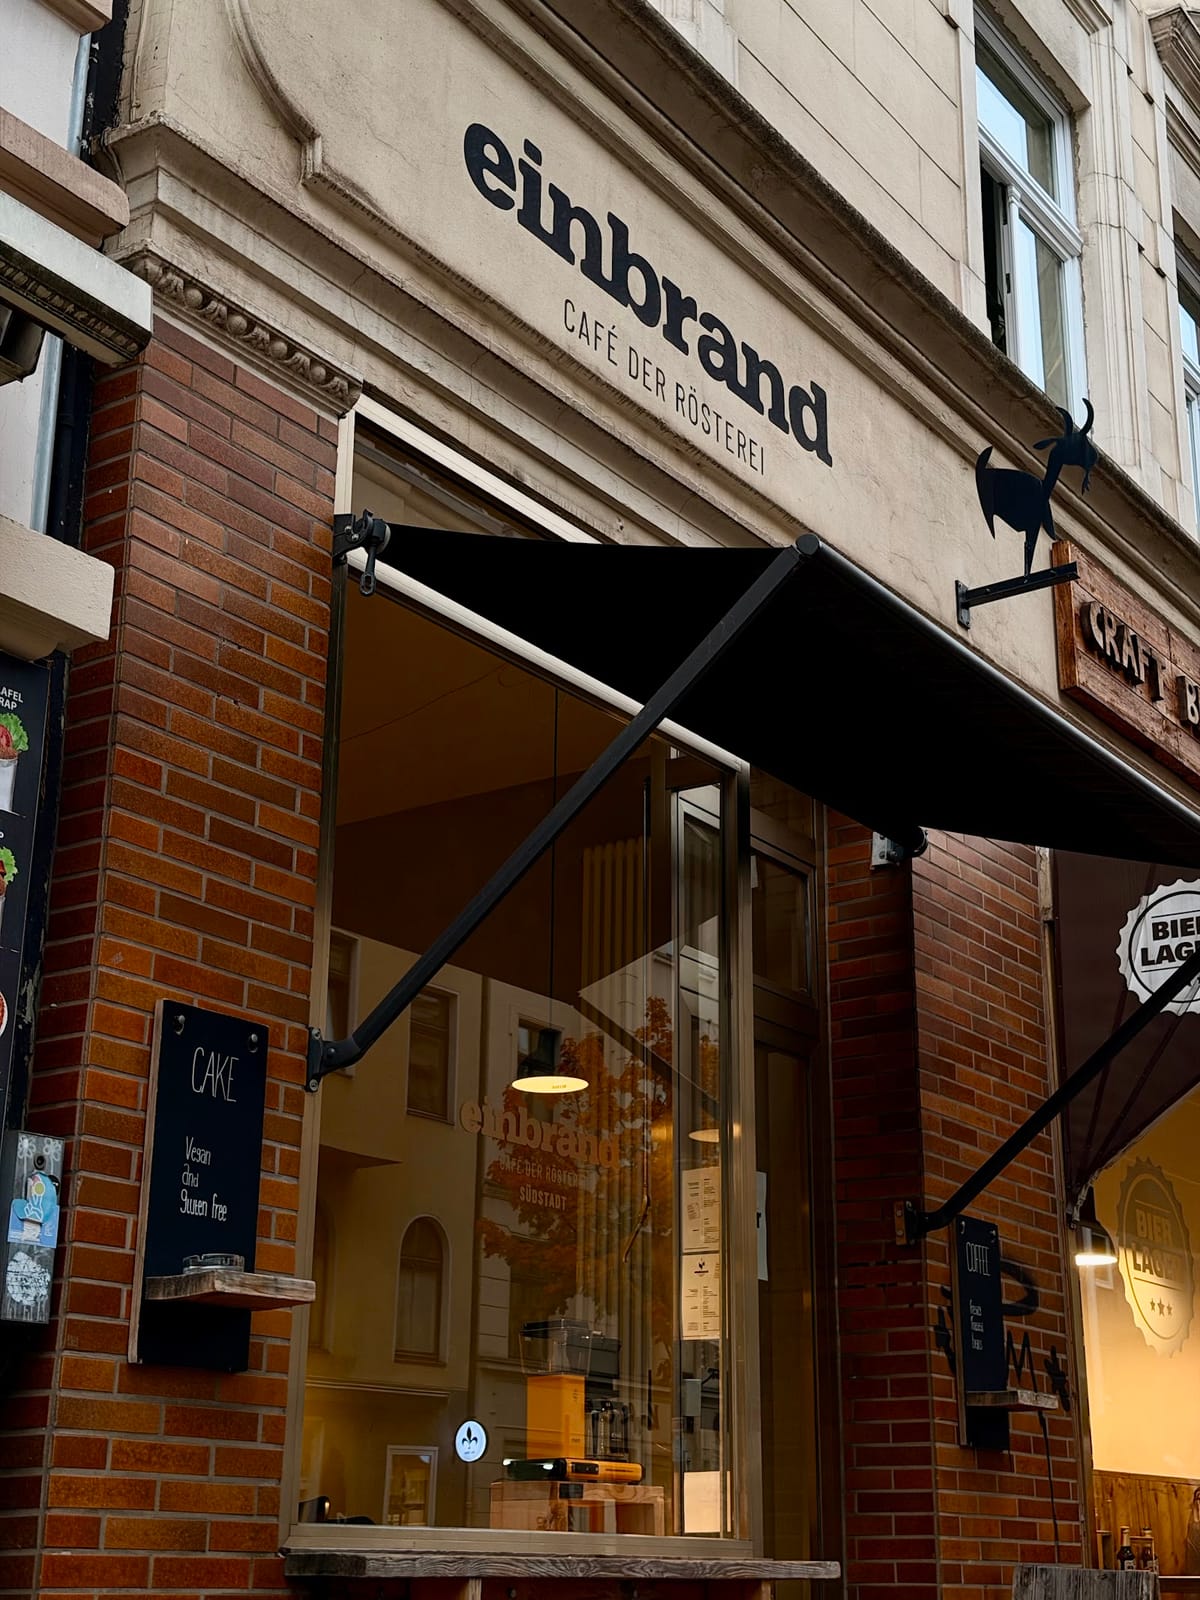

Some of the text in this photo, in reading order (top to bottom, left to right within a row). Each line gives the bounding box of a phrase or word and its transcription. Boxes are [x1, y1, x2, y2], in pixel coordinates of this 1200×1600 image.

[463, 123, 833, 468] einbrand
[563, 298, 765, 476] CAFÉ DER RÖSTEREI
[1080, 601, 1200, 728] CRAFT B
[191, 1046, 239, 1102] CAKE
[185, 1136, 211, 1165] Vegan
[460, 1097, 620, 1169] einbrand
[182, 1163, 199, 1187] and
[545, 1164, 587, 1190] RÖSTER
[180, 1188, 228, 1222] gluten free
[519, 1183, 567, 1211] SÜDSTADT
[1135, 1208, 1174, 1247] BIER
[966, 1242, 991, 1277] COFFEE
